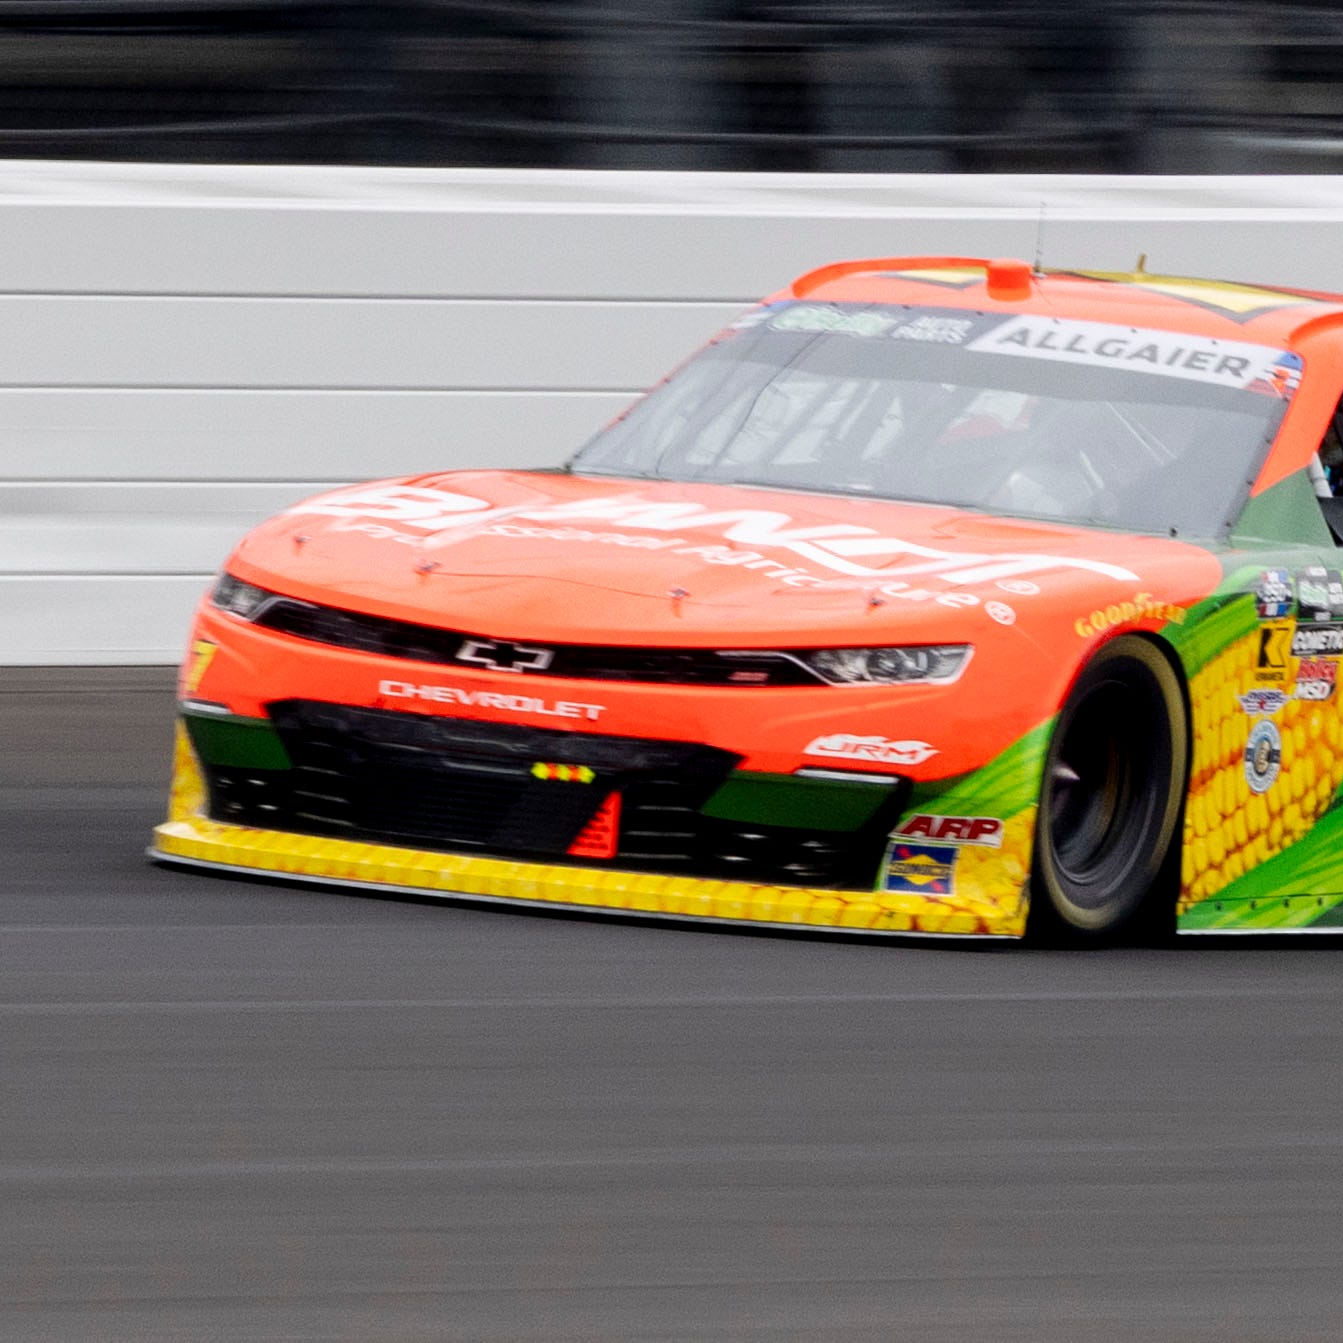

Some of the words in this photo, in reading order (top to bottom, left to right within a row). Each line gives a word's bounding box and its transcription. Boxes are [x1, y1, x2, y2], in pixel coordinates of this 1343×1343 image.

[997, 326, 1252, 380] ALLGAIER
[379, 680, 606, 721] CHEVROLET
[817, 742, 918, 759] JRM
[900, 816, 1000, 840] ARP
